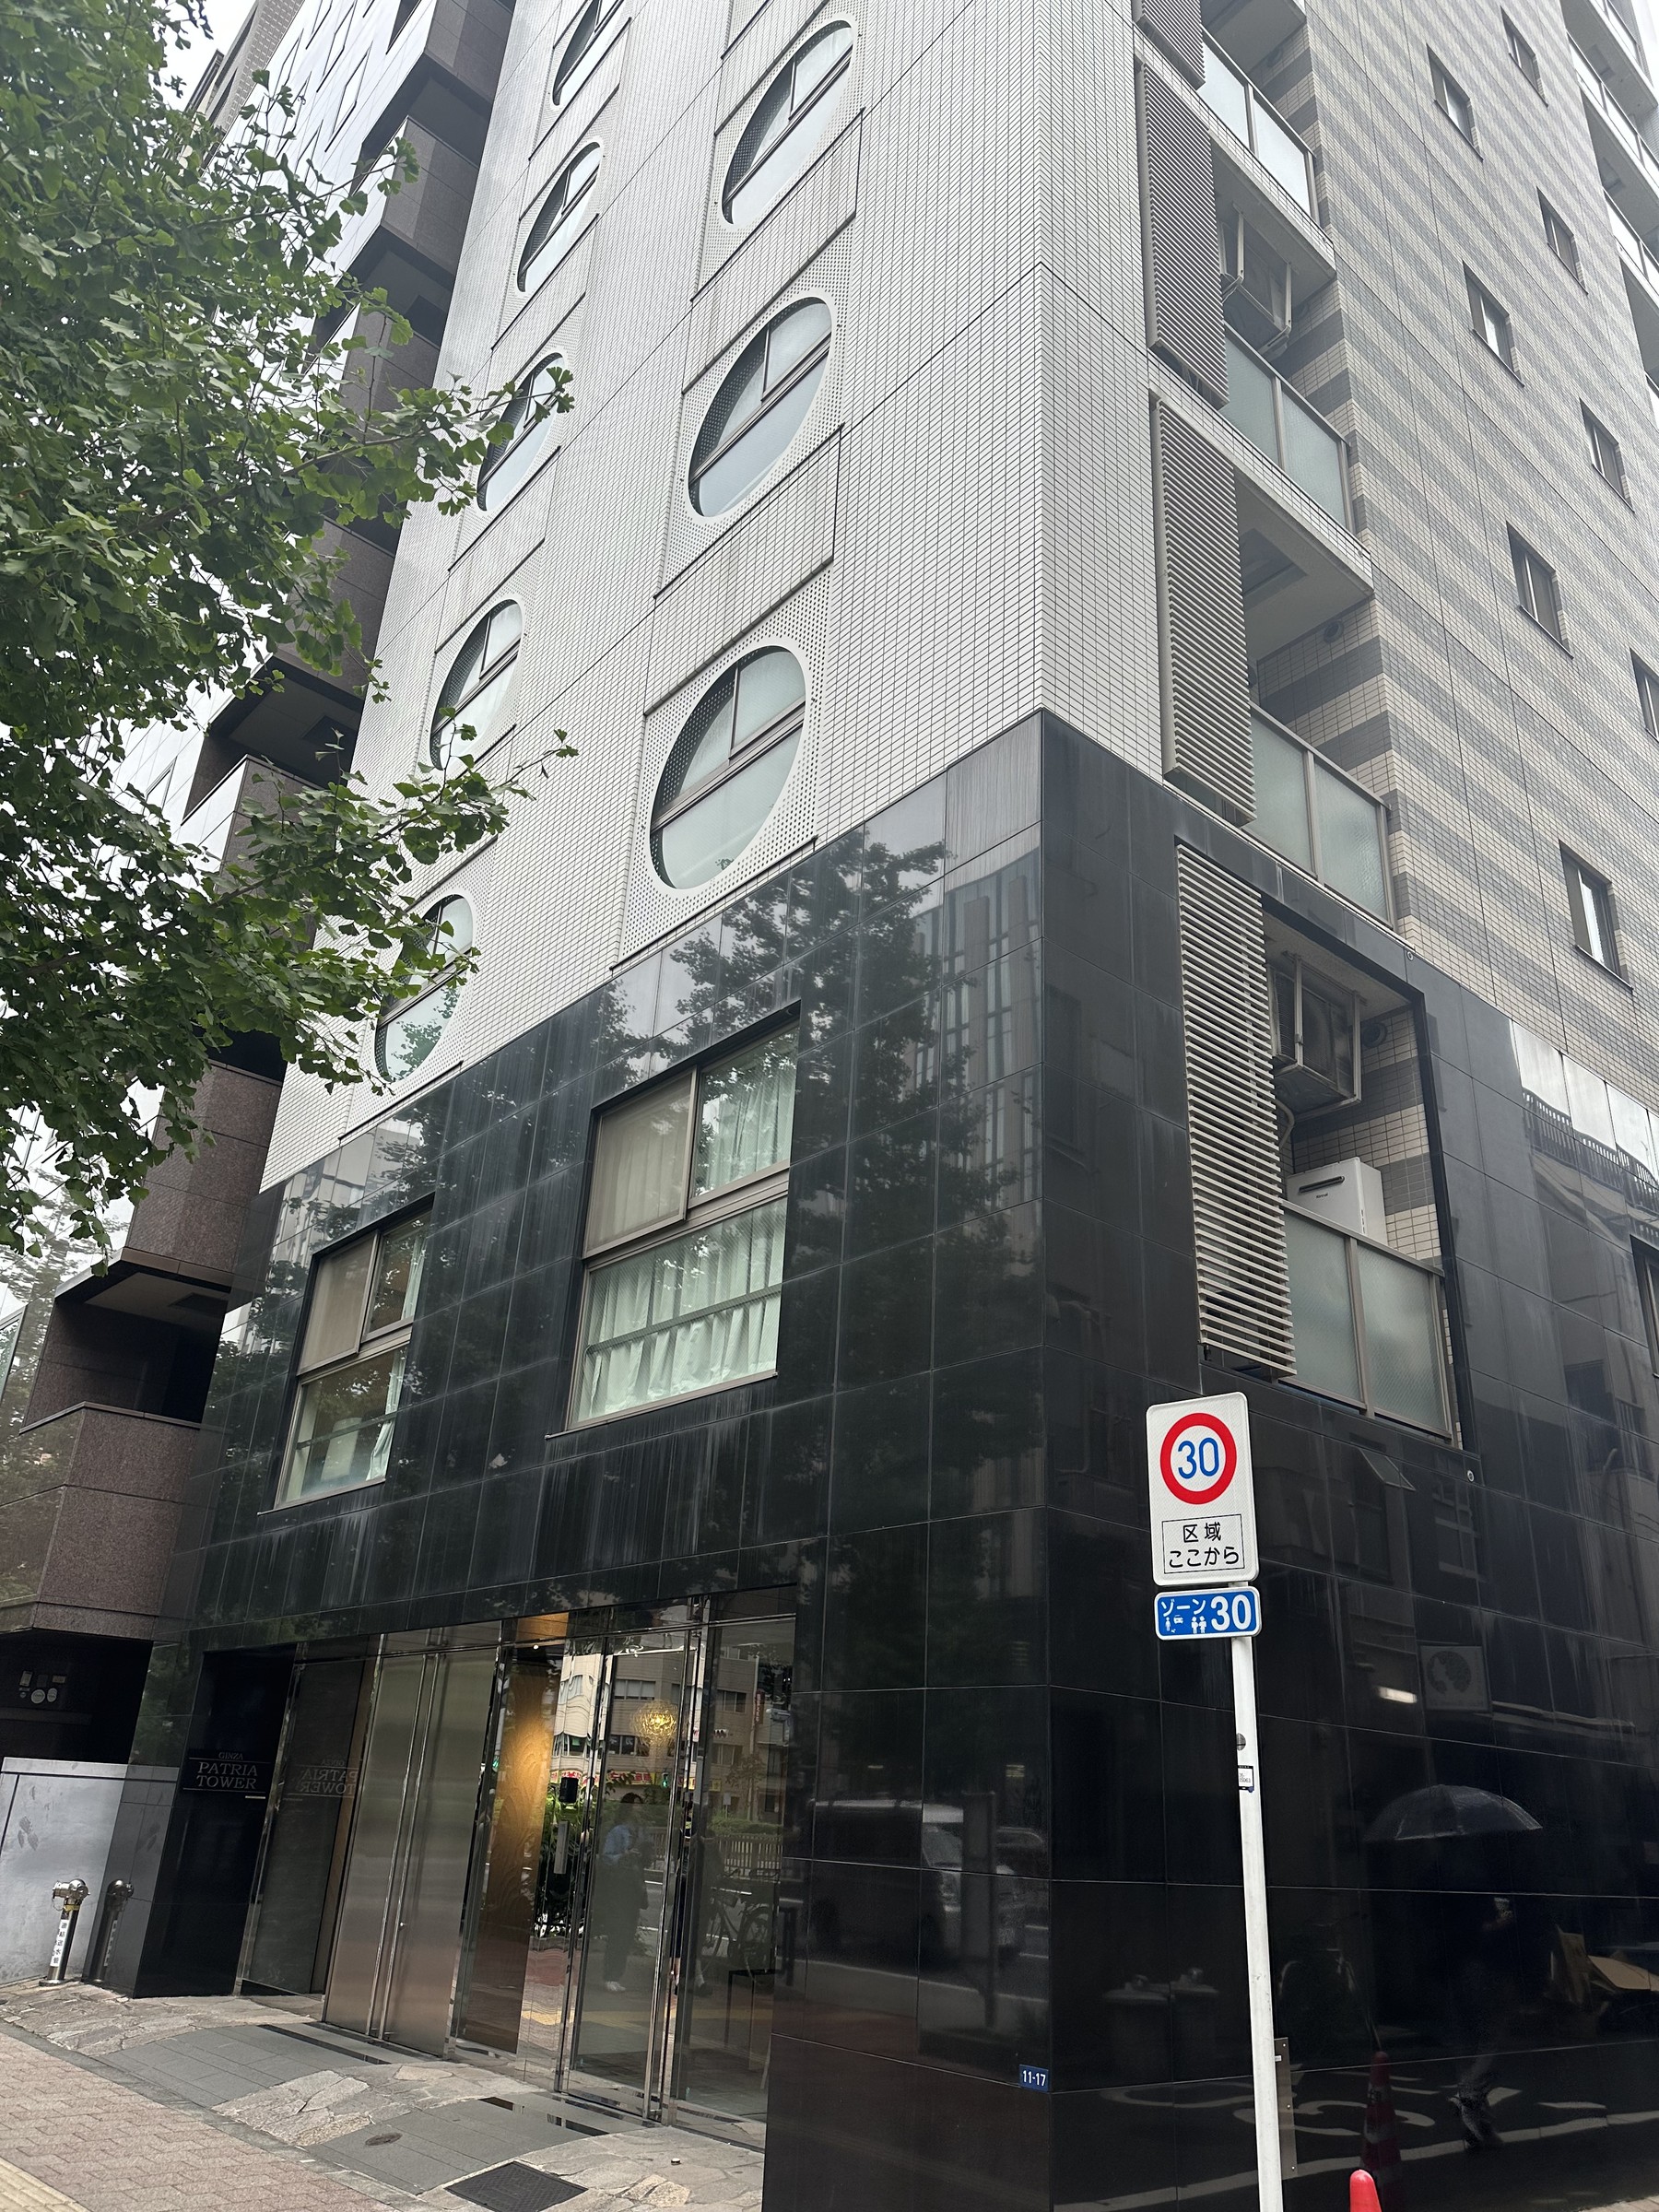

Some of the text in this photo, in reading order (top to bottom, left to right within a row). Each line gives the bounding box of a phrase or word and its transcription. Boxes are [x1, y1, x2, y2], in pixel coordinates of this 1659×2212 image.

[1177, 1437, 1220, 1479] 30
[1182, 1522, 1222, 1544] 区域
[1169, 1546, 1240, 1569] ここから
[196, 1761, 258, 1777] PATRIA
[195, 1774, 257, 1790] TOWER
[1022, 2069, 1047, 2087] 11-17
